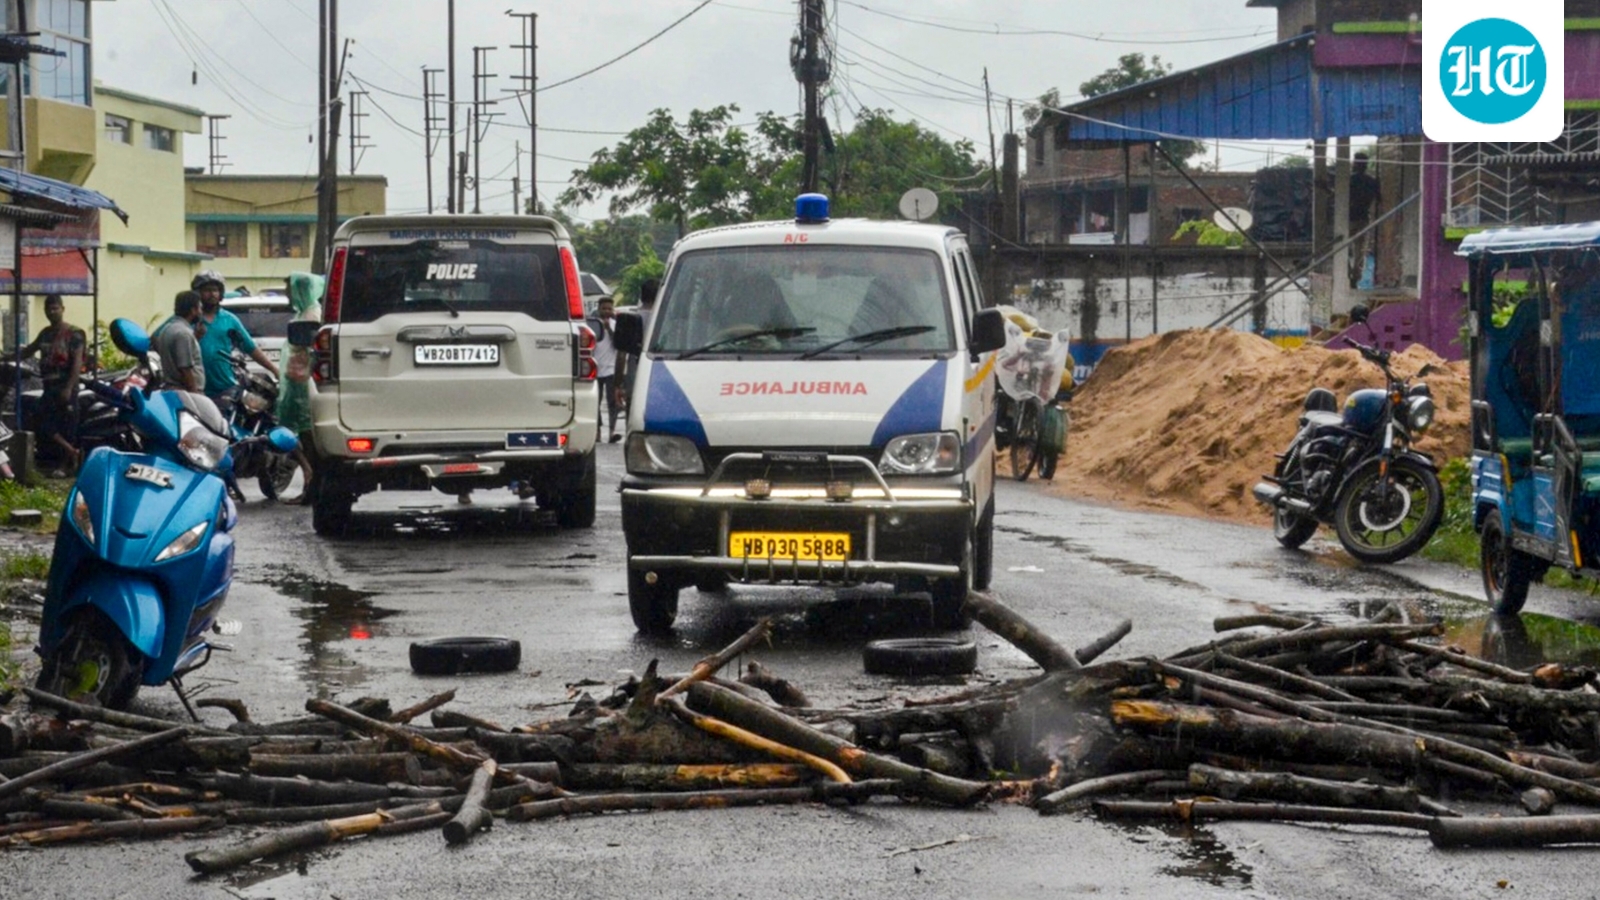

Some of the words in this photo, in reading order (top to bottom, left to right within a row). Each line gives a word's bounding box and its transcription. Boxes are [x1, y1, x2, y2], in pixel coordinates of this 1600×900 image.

[439, 229, 474, 240] POLICE
[475, 229, 518, 240] DISTRICT
[783, 233, 809, 245] A/C
[426, 263, 478, 280] POLICE
[422, 347, 497, 361] WB20BT7412
[803, 538, 846, 557] 5888
